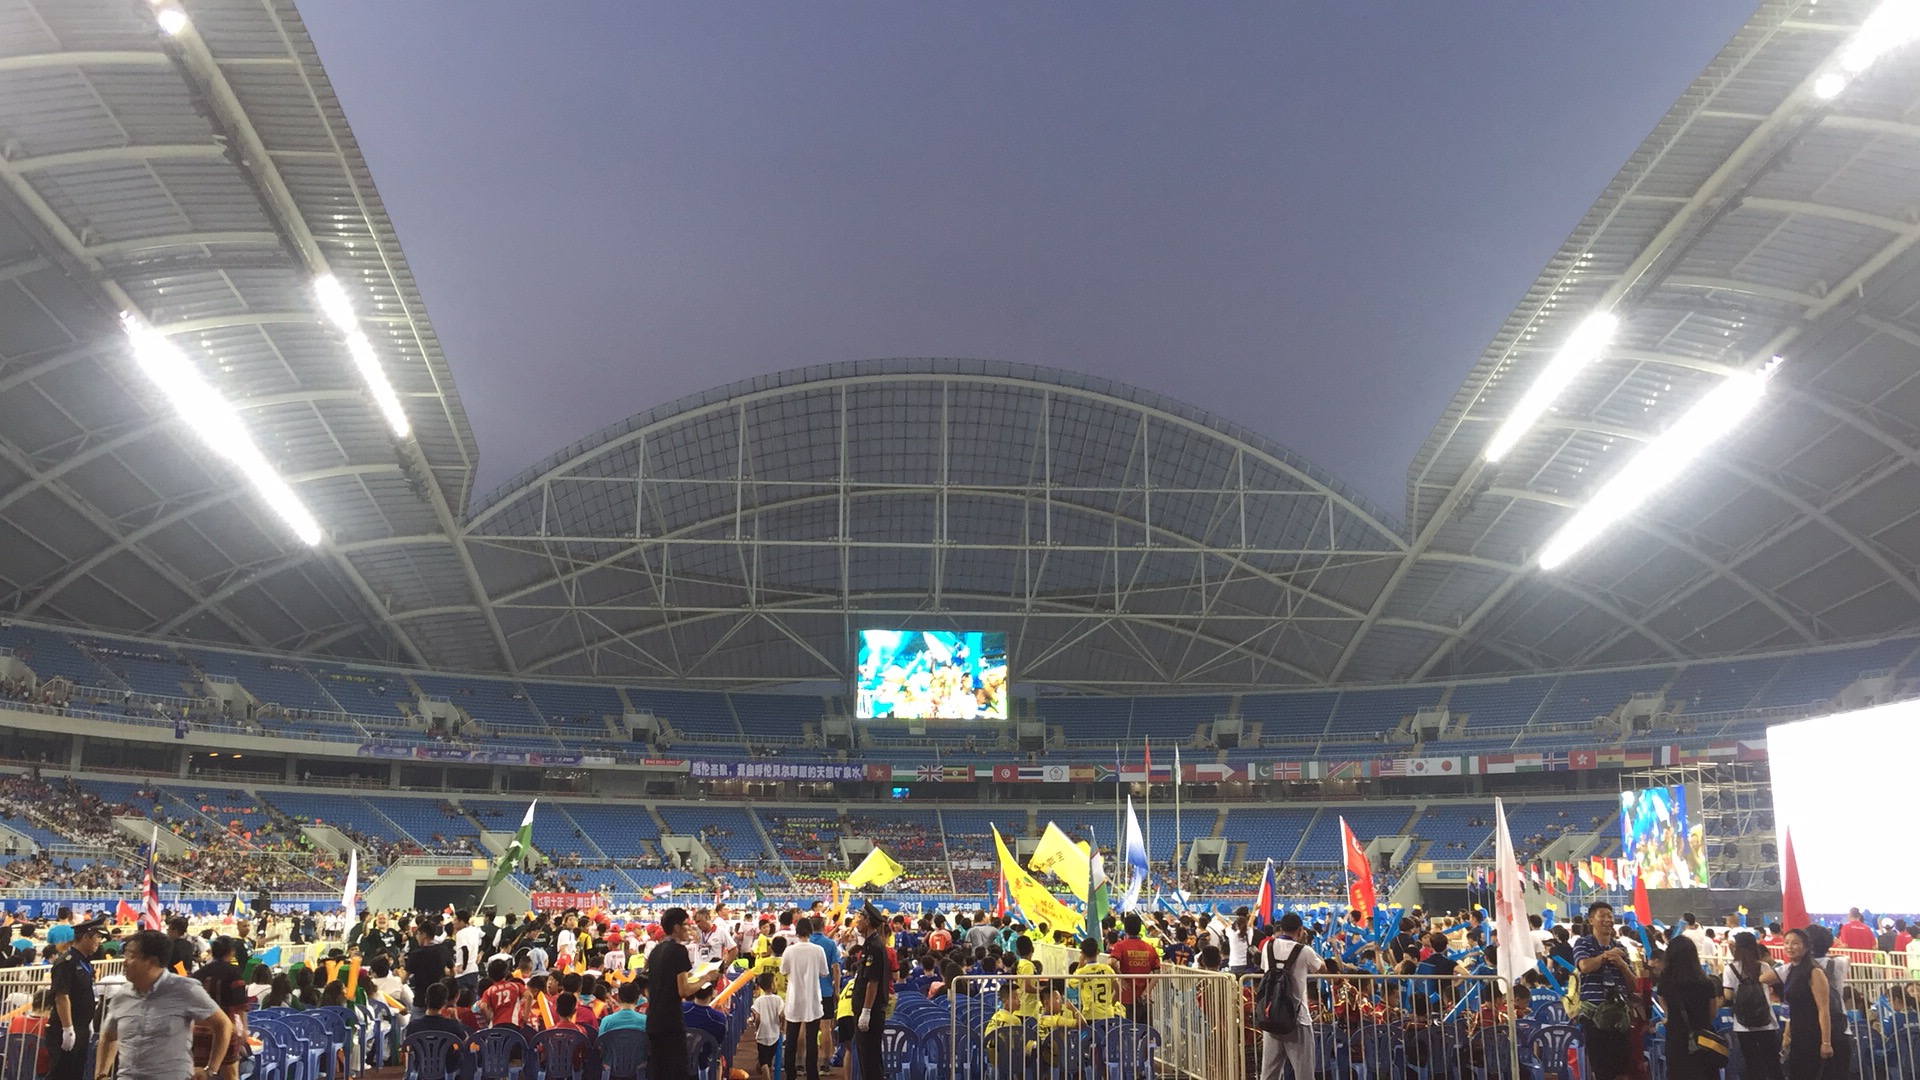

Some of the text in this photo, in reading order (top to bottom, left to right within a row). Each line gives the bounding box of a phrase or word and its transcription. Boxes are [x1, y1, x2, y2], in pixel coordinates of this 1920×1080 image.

[41, 902, 61, 916] 2017
[166, 903, 192, 914] CHNA
[899, 902, 921, 913] 2017
[496, 990, 511, 1006] 12
